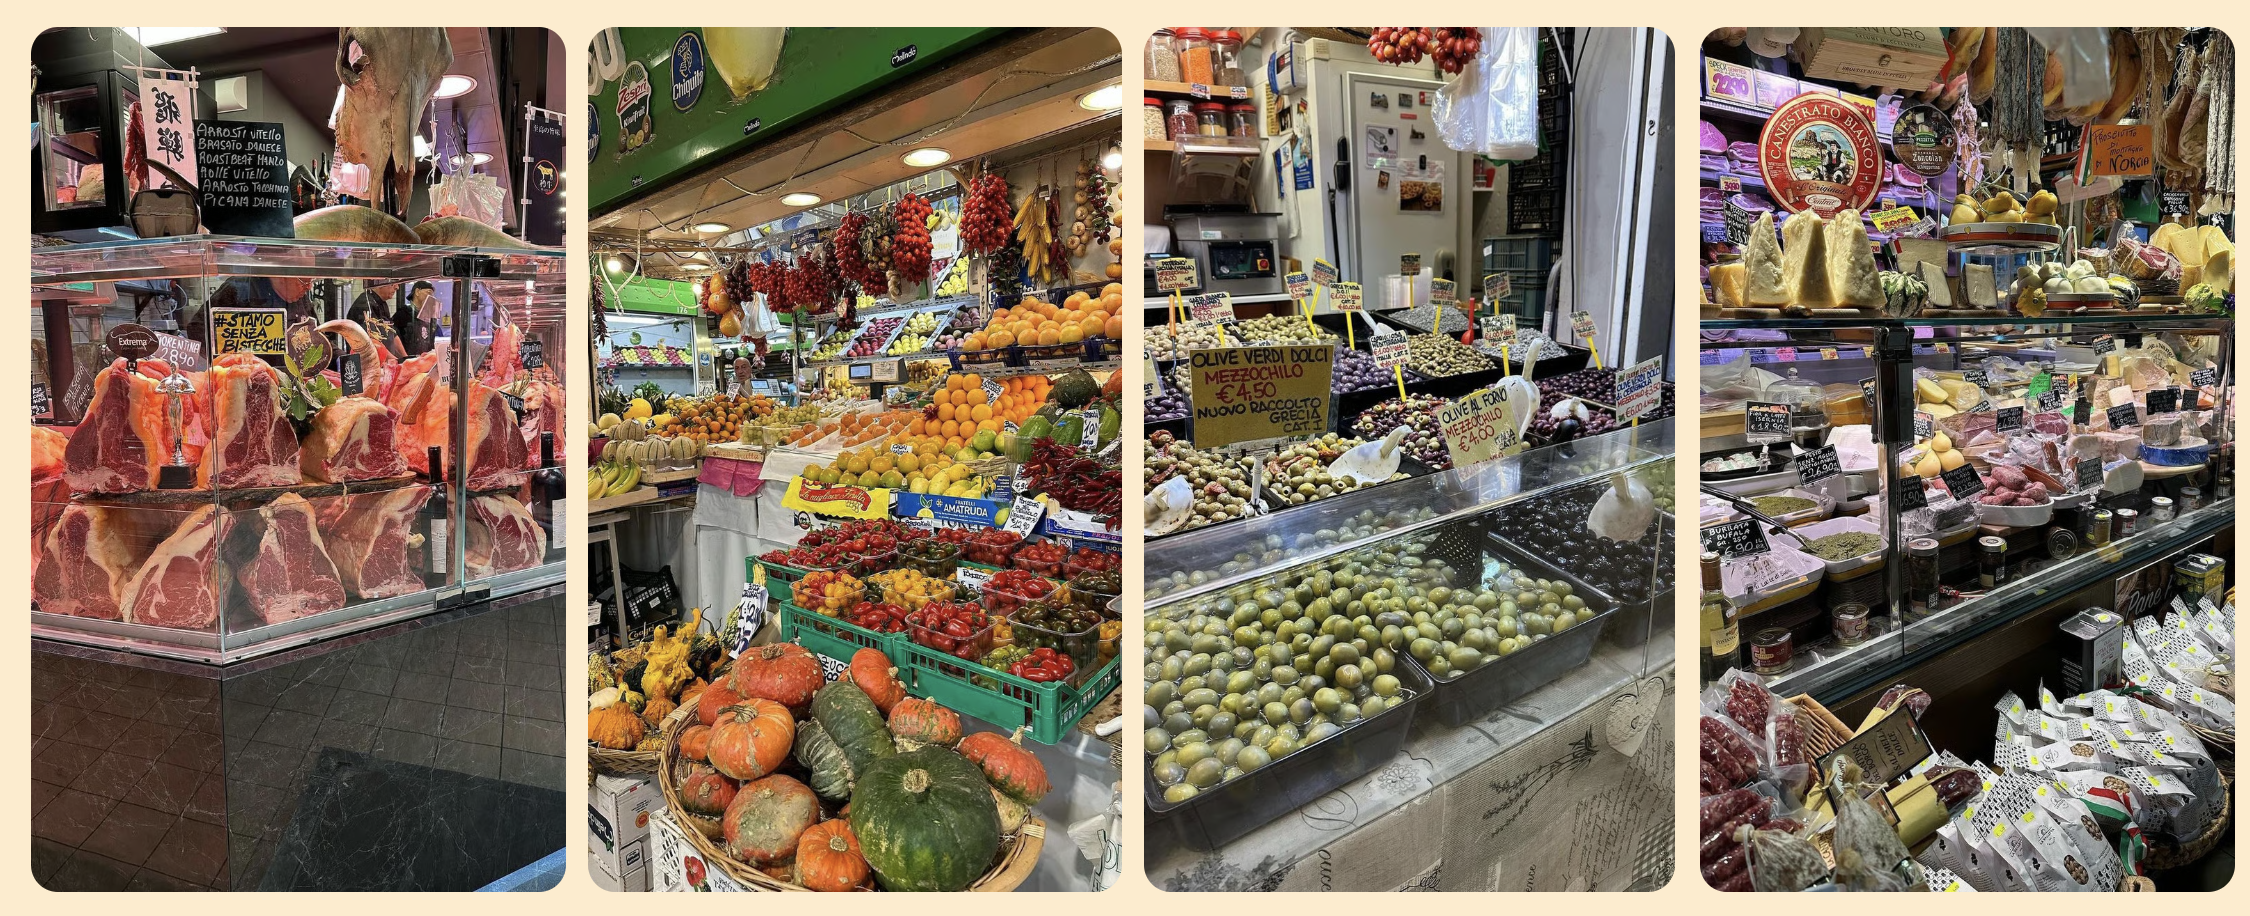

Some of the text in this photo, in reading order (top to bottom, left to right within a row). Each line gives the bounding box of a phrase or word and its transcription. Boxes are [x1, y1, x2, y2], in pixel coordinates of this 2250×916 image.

[1708, 60, 1727, 71] SPECK
[672, 67, 704, 101] Chiquita
[617, 78, 648, 114] Zespri
[1770, 104, 1841, 159] CANESTRATO
[2093, 127, 2136, 145] PROSCIUTTO
[198, 138, 281, 152] BRASATO DANESE
[1844, 115, 1874, 169] BIANCO
[257, 155, 284, 166] MANZO
[2109, 155, 2149, 173] NORCIA
[202, 179, 249, 192] ARROSTO
[204, 193, 249, 207] PICANA
[215, 313, 275, 328] #STAMO
[119, 337, 147, 347] Extrema
[221, 328, 267, 339] SENZA
[222, 338, 287, 353] BISTECCHE
[1192, 347, 1328, 368] OLIVE VERDI DOLCI
[1204, 363, 1303, 385] MEZZOCHILO
[1197, 397, 1321, 419] NUOVO RACCOLTO
[1442, 388, 1508, 423] OLIVE AL FORNO
[1269, 408, 1321, 424] GRECIA
[1445, 407, 1503, 438] MEZZOCHILO
[1283, 419, 1322, 433] CAT. I
[1805, 450, 1822, 458] PESTO
[943, 504, 988, 518] AMATRUDA
[1717, 529, 1750, 541] BUFALA
[2126, 587, 2162, 621] Pane
[1888, 731, 1905, 757] DOLCE
[1852, 742, 1870, 779] CANTINA
[1861, 742, 1876, 772] BORGO
